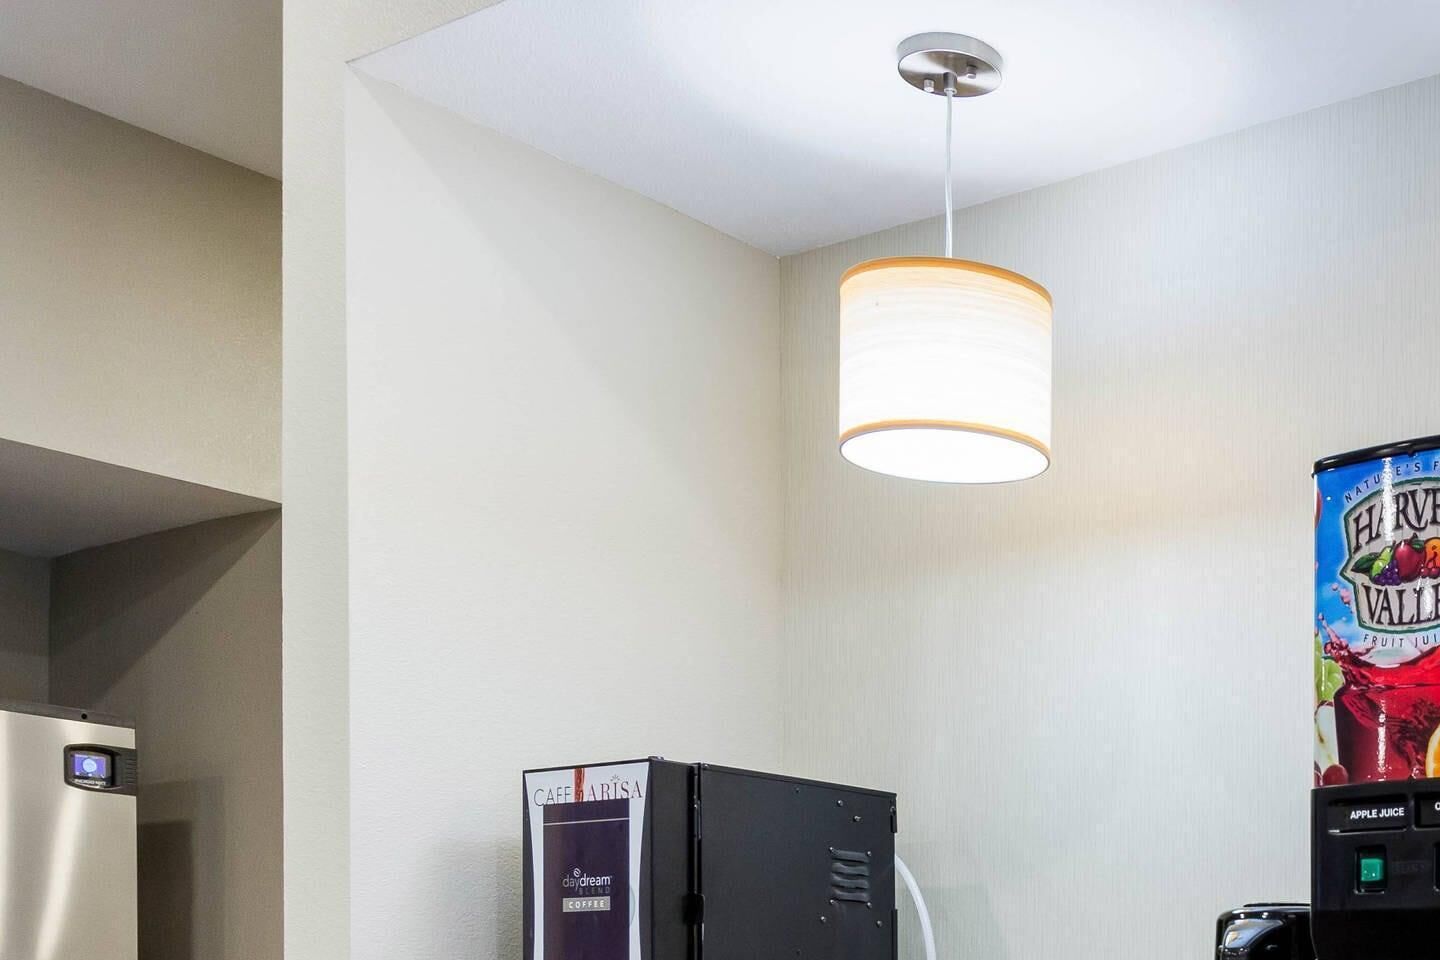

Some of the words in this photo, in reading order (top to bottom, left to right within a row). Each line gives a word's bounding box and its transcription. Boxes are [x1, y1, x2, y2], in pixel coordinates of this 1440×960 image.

[1344, 462, 1421, 503] NATUE'S
[1363, 633, 1405, 648] FRUIT
[1350, 808, 1378, 820] APPLE
[1379, 807, 1405, 818] JUICE
[562, 873, 611, 891] daydream
[568, 900, 605, 909] COFFEE
